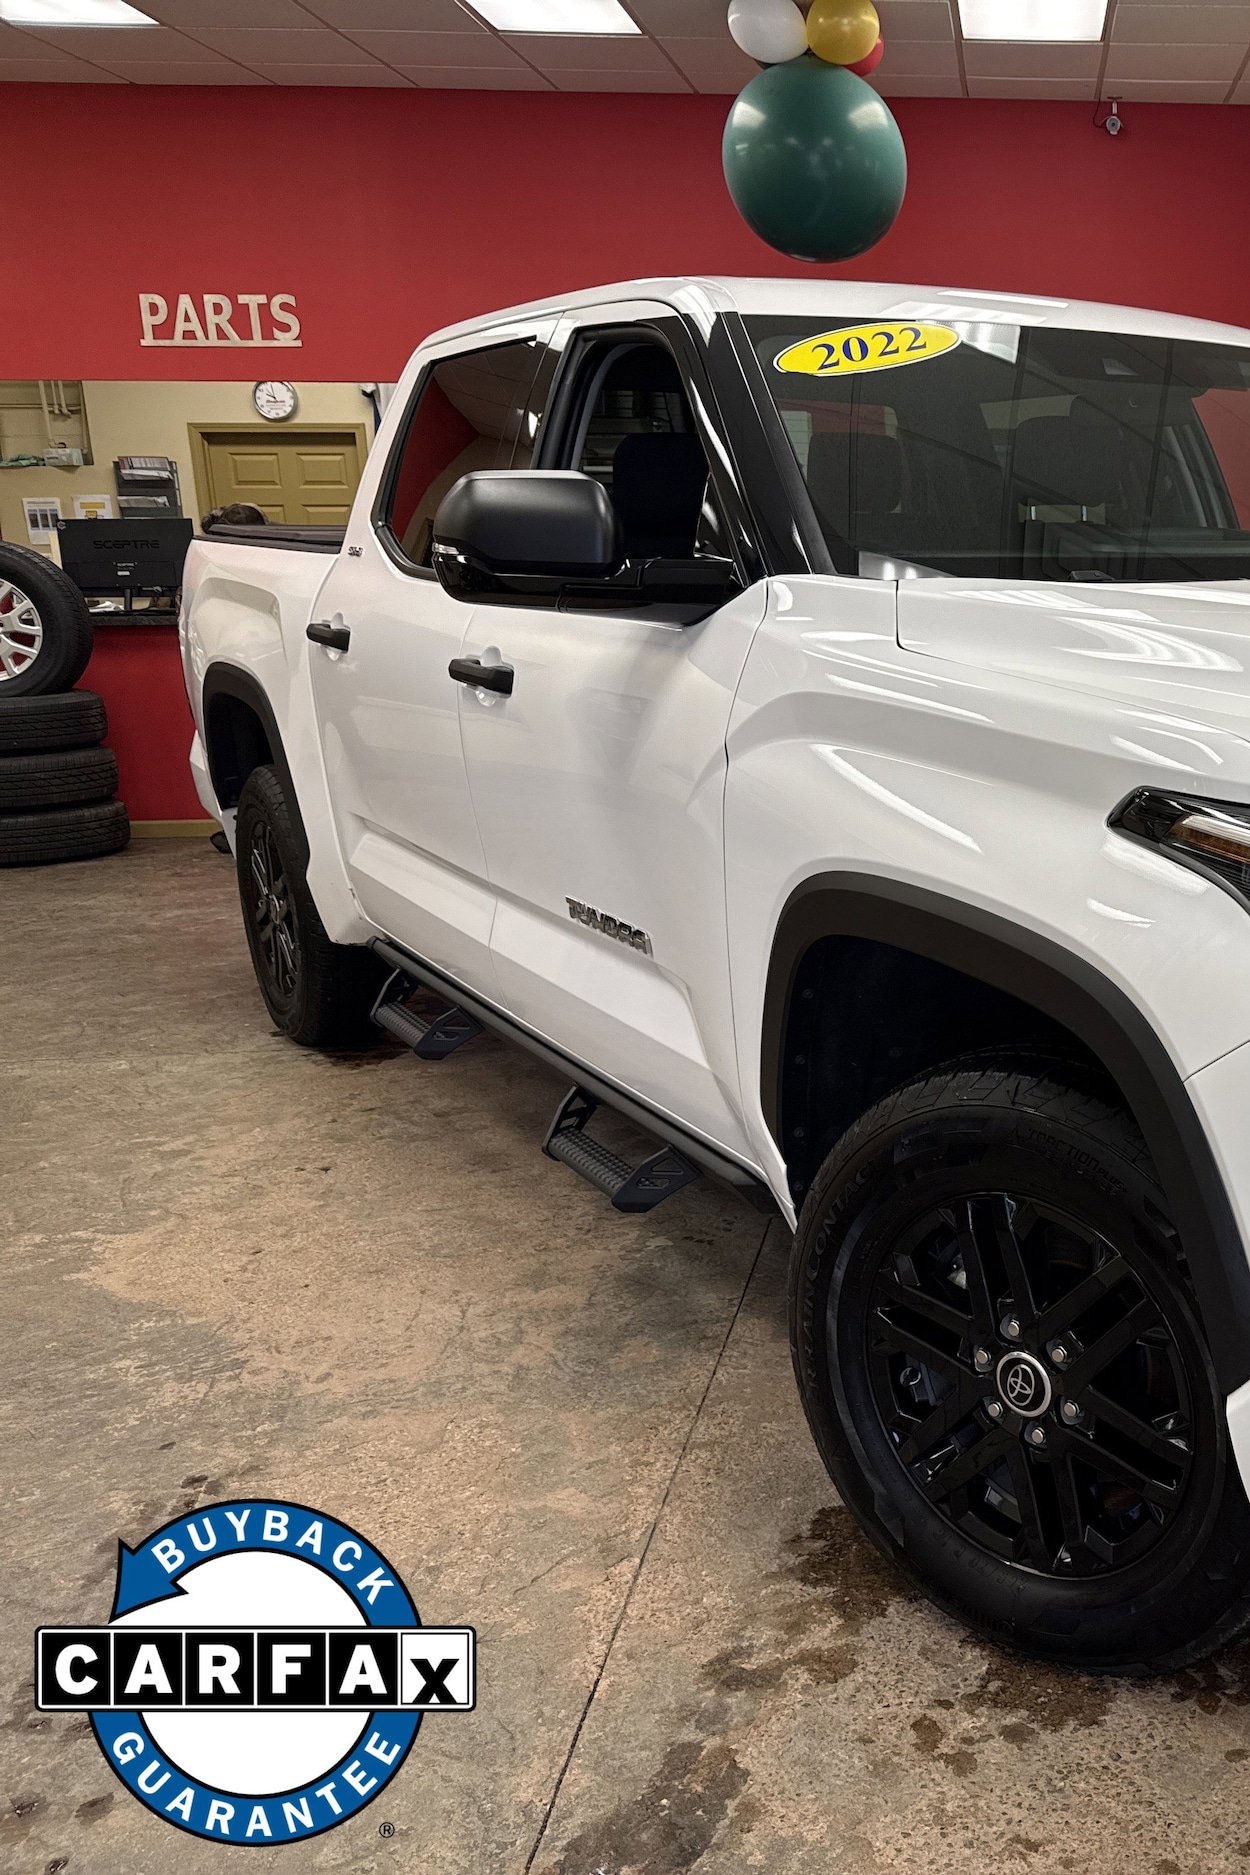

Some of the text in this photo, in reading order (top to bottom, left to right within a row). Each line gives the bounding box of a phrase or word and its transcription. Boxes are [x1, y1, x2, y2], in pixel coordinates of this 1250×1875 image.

[138, 293, 302, 347] PARTS
[811, 326, 927, 371] 2022
[93, 540, 161, 550] SCEPTRE
